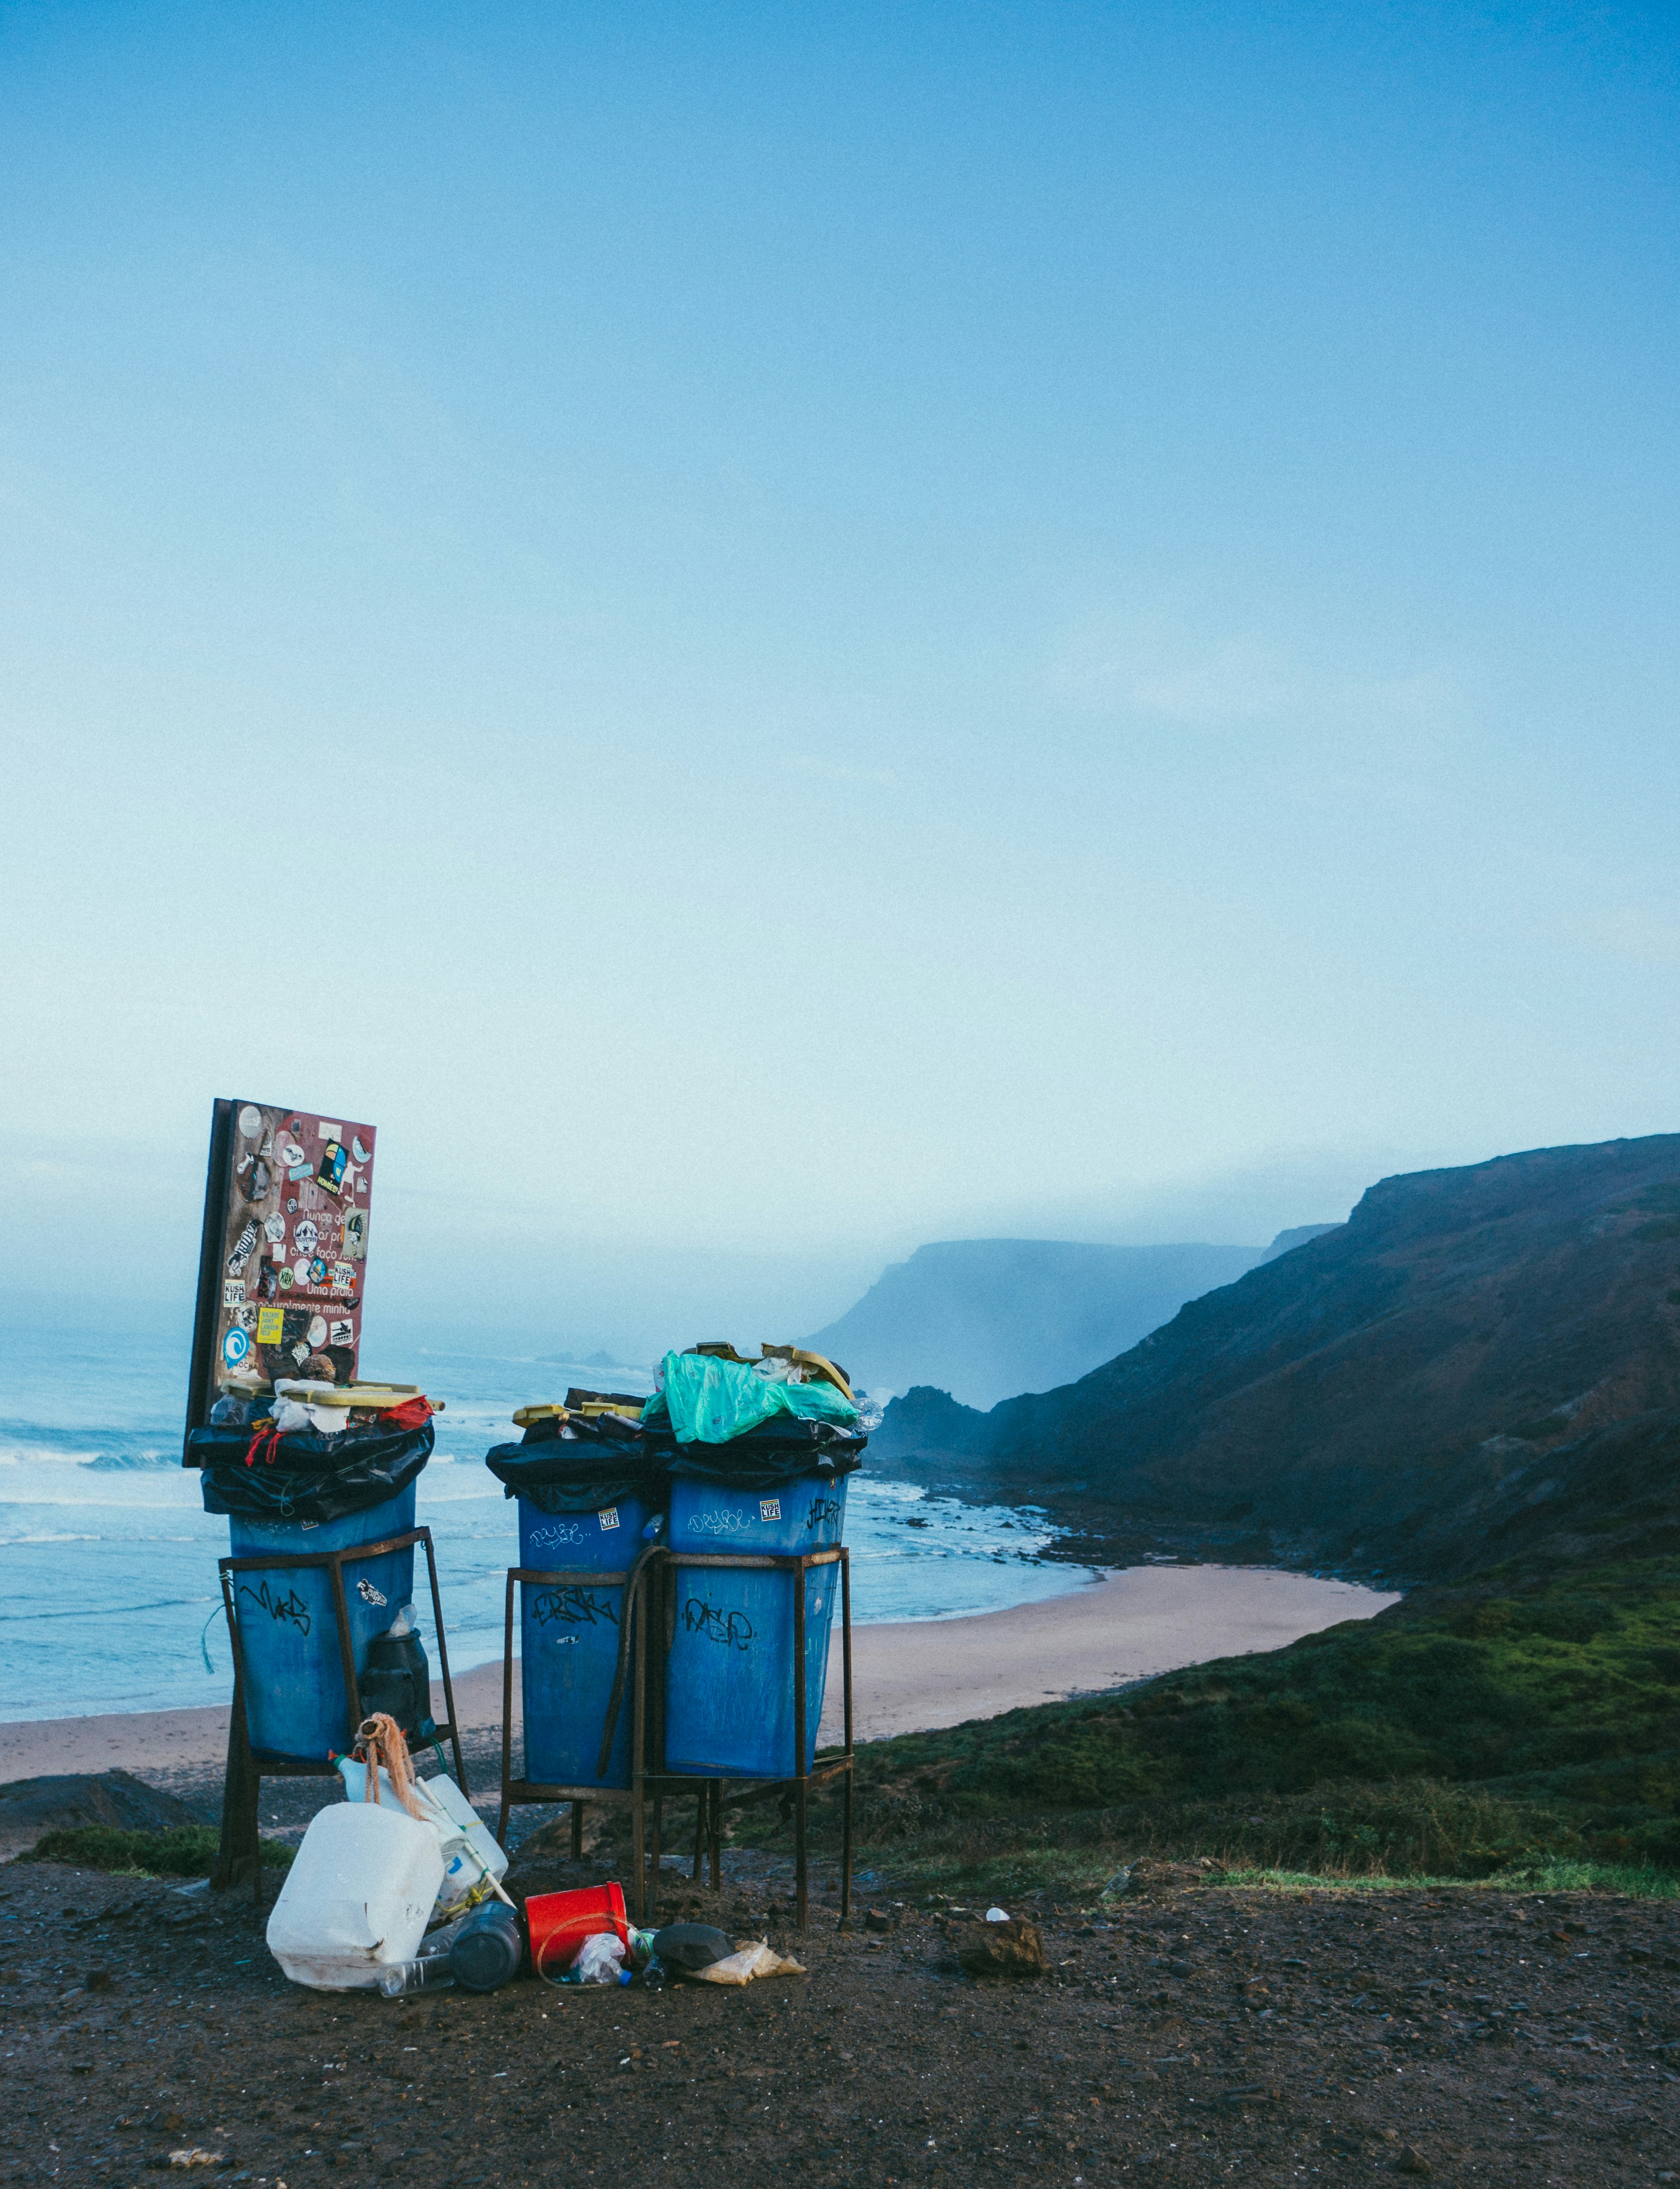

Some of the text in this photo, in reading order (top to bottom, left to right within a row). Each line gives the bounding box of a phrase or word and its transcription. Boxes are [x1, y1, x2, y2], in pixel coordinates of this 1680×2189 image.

[335, 1266, 351, 1276] KUSH
[334, 1274, 350, 1284] LIFE
[307, 1283, 328, 1295] Uma
[224, 1293, 245, 1302] LIFE
[600, 1512, 617, 1520] KUSH
[762, 1509, 780, 1517] LIFE
[601, 1517, 618, 1526] LIFE
